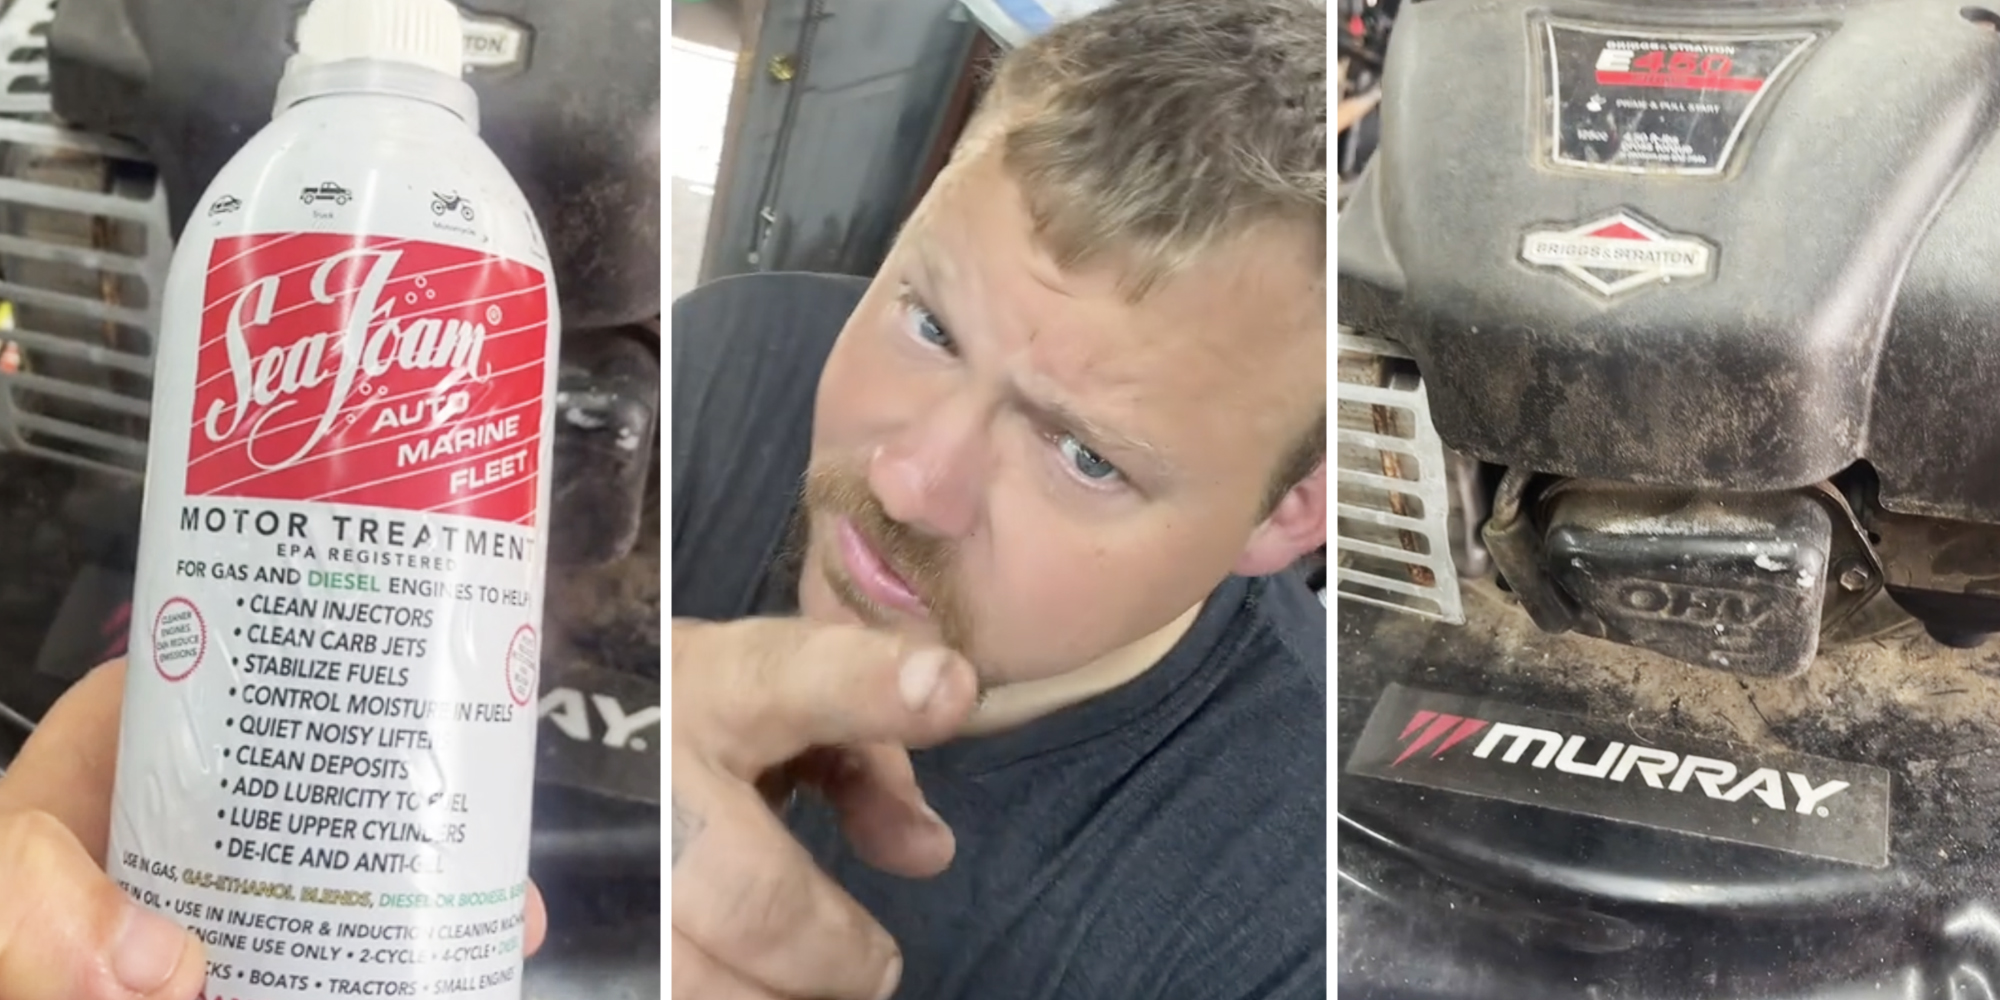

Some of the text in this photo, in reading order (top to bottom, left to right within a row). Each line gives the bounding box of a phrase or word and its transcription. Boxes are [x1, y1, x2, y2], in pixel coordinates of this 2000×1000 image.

[371, 390, 470, 434] AUTO
[397, 415, 521, 468] MARINE
[450, 451, 529, 494] FLEET
[180, 506, 536, 562] MOTOR TREATMENT
[276, 543, 458, 572] EPA REGISTERED
[176, 560, 207, 579] FOR
[211, 561, 249, 583] GAS
[253, 565, 302, 586] AND
[306, 570, 382, 594] DIESEL
[388, 576, 475, 602] ENGINES
[478, 586, 500, 605] TO
[249, 593, 435, 630] CLEAN INJECTORS
[247, 623, 429, 659] CLEAN CARB JETS
[243, 652, 411, 687] STABILIZE FUELS
[242, 683, 342, 713] CONTROL
[454, 702, 471, 722] IN
[474, 703, 514, 724] FUELS
[239, 714, 436, 751] QUIET NOISY LIFTE
[236, 744, 410, 780] CLEAN DEPOSITS
[232, 776, 469, 813] ADD LUBRICITY TO FEL
[231, 806, 467, 845] LUBE UPPER CYLINRS
[227, 837, 445, 875] DE-ICE AND ANTI-GL
[151, 861, 179, 883] GAS,
[182, 867, 297, 901] GAS-ETHANOL
[143, 889, 162, 909] OIL
[175, 898, 204, 919] USE
[206, 905, 225, 925] IN
[227, 910, 316, 936] INJECTOR
[318, 921, 332, 936] &
[437, 919, 499, 940] CLEANING
[187, 925, 248, 951] NGINE
[251, 936, 287, 956] USE
[290, 942, 343, 962] ONLY
[358, 948, 430, 965] 2-CYCLE
[441, 943, 490, 962] 4-CYCLE
[248, 969, 310, 992] BOATS
[328, 978, 418, 997] TRACTORS
[433, 976, 477, 996] SMALL
